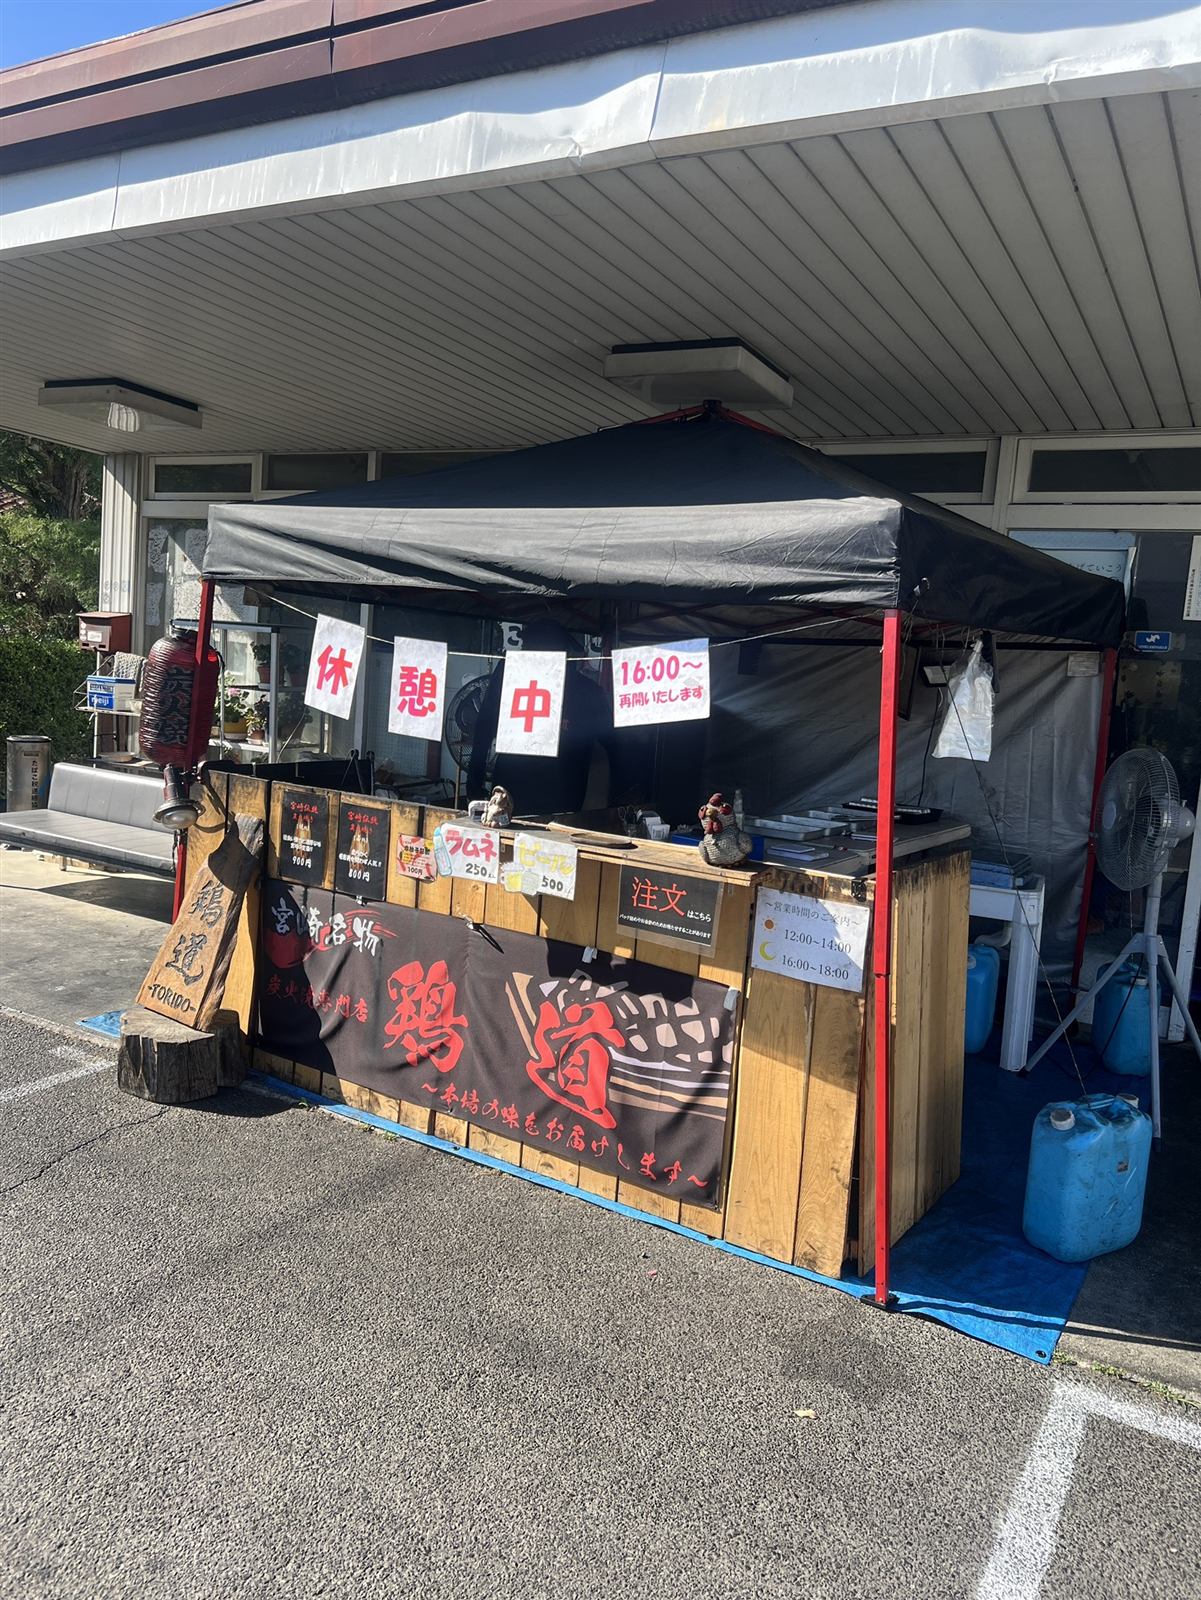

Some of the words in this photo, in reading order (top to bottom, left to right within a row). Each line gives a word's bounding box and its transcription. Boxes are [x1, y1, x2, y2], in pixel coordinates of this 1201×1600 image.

[317, 644, 353, 696] 休
[397, 665, 437, 717] 憩
[619, 685, 704, 709] 再開いたします
[510, 679, 551, 733] 中
[444, 830, 498, 864] ラムネ
[518, 840, 575, 877] ビール
[291, 856, 312, 869] 900円
[348, 869, 370, 882] 800円
[407, 866, 423, 876] 100円
[783, 929, 852, 954] 12:00~14:00
[781, 955, 850, 981] 16:00~18:00
